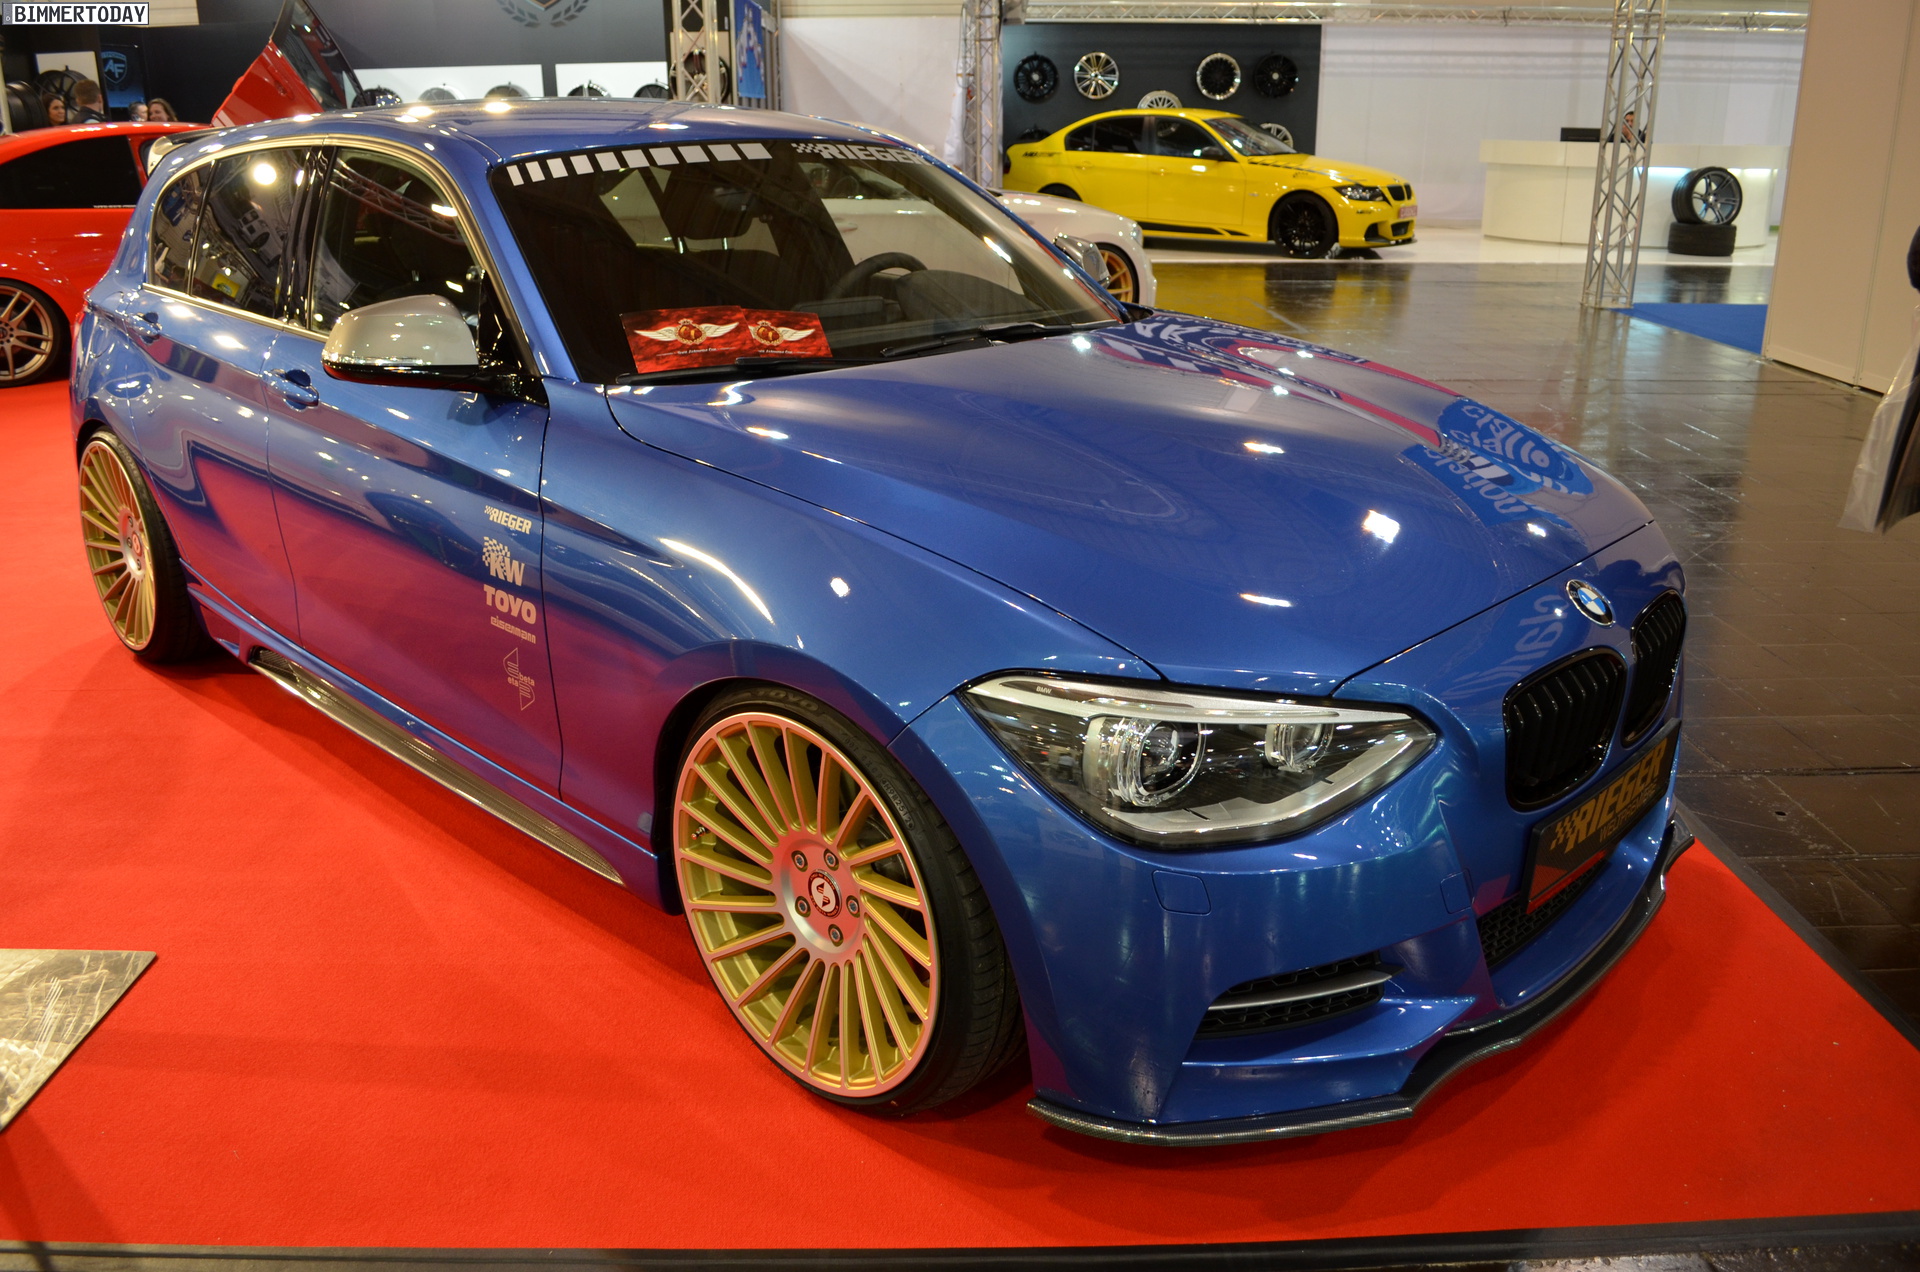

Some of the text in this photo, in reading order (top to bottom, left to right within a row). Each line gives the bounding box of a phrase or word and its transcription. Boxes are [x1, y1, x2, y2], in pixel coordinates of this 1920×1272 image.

[817, 143, 933, 167] RIEGER
[488, 508, 532, 534] RIEGER
[489, 551, 525, 587] KW
[483, 584, 537, 625] TOYO
[1036, 685, 1052, 695] BMW
[1564, 737, 1668, 855] RIEGER
